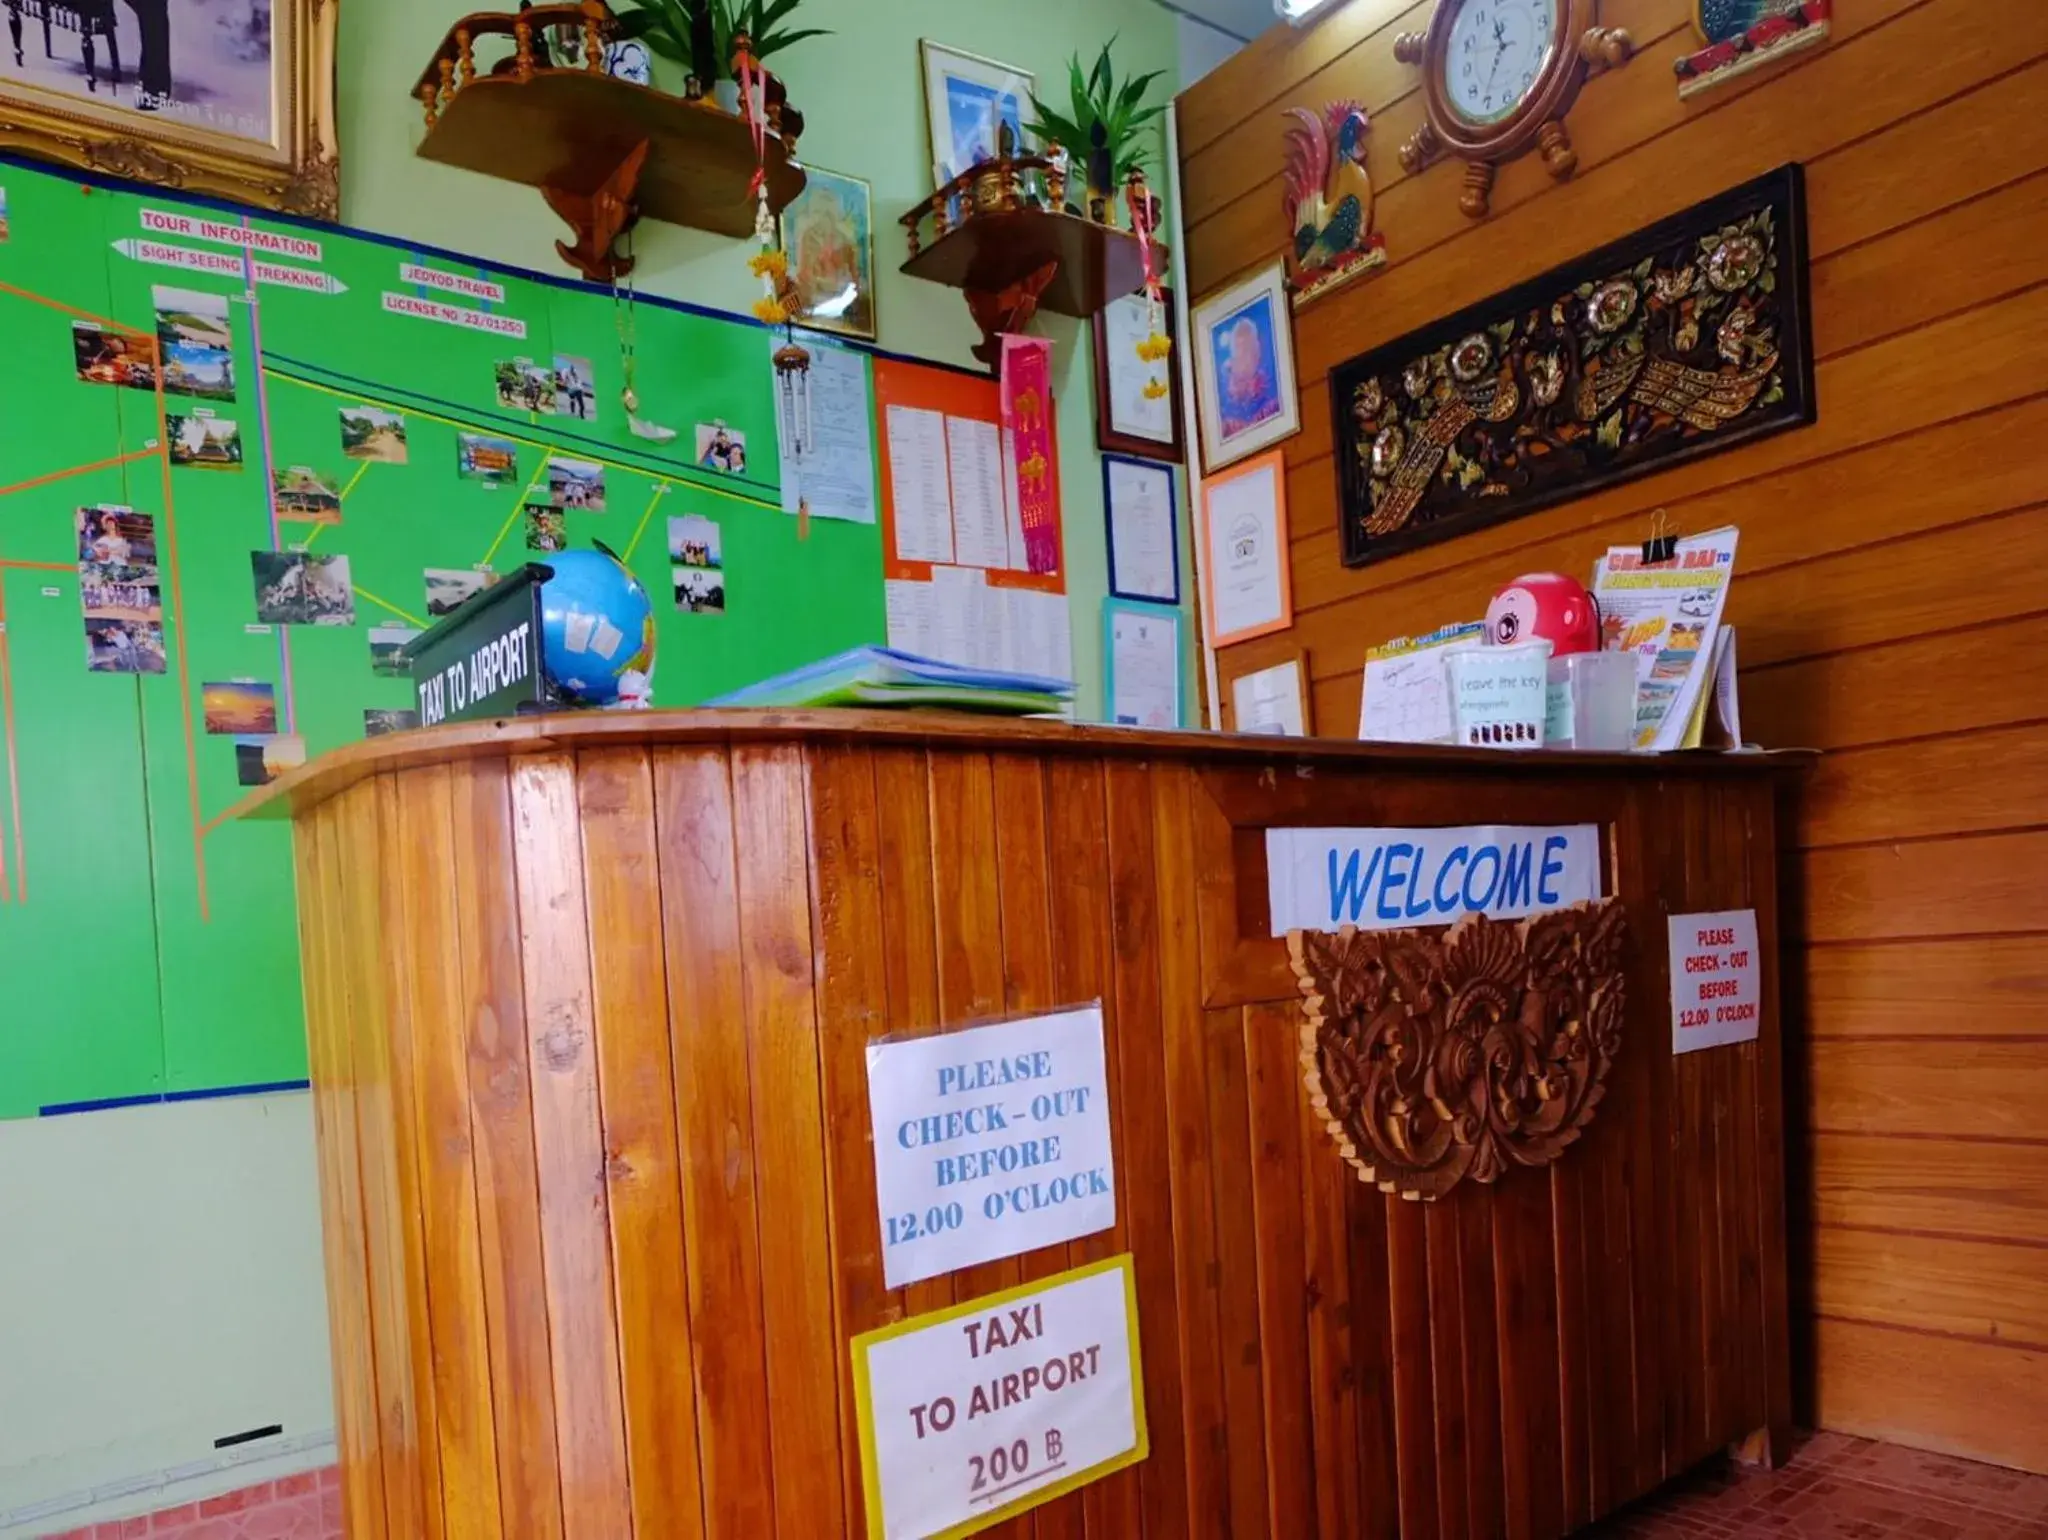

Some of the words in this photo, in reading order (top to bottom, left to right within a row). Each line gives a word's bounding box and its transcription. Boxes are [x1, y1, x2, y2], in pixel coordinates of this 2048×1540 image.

[142, 212, 191, 233] TOUR
[200, 222, 318, 257] INFORMATION
[140, 245, 183, 262] SIGHT
[189, 253, 241, 272] SEEING
[255, 265, 325, 288] TREKKING
[407, 267, 454, 287] JEDYOD
[457, 279, 499, 299] TRAVEL
[386, 296, 440, 317] LICENSE
[419, 672, 446, 728] TAXI
[447, 664, 465, 714] TO
[469, 622, 530, 704] AIRPORT
[1498, 675, 1517, 690] the
[1328, 835, 1568, 922] WELCOME
[1697, 928, 1734, 946] PLEASE
[1685, 954, 1720, 973] CHECK
[1730, 951, 1748, 969] OUT
[1698, 980, 1738, 1000] BEFORE
[1680, 1008, 1709, 1028] 12.00
[1716, 1003, 1755, 1023] O'CLOCK
[937, 1051, 1052, 1096] PLEASE
[934, 1136, 1062, 1187] BEFORE
[887, 1202, 964, 1246] 12.00
[983, 1167, 1109, 1220] O'CLOCK
[963, 1302, 1044, 1358] TAXI
[909, 1396, 956, 1439] TO
[968, 1344, 1101, 1420] AIRPORT
[968, 1438, 1029, 1492] 200
